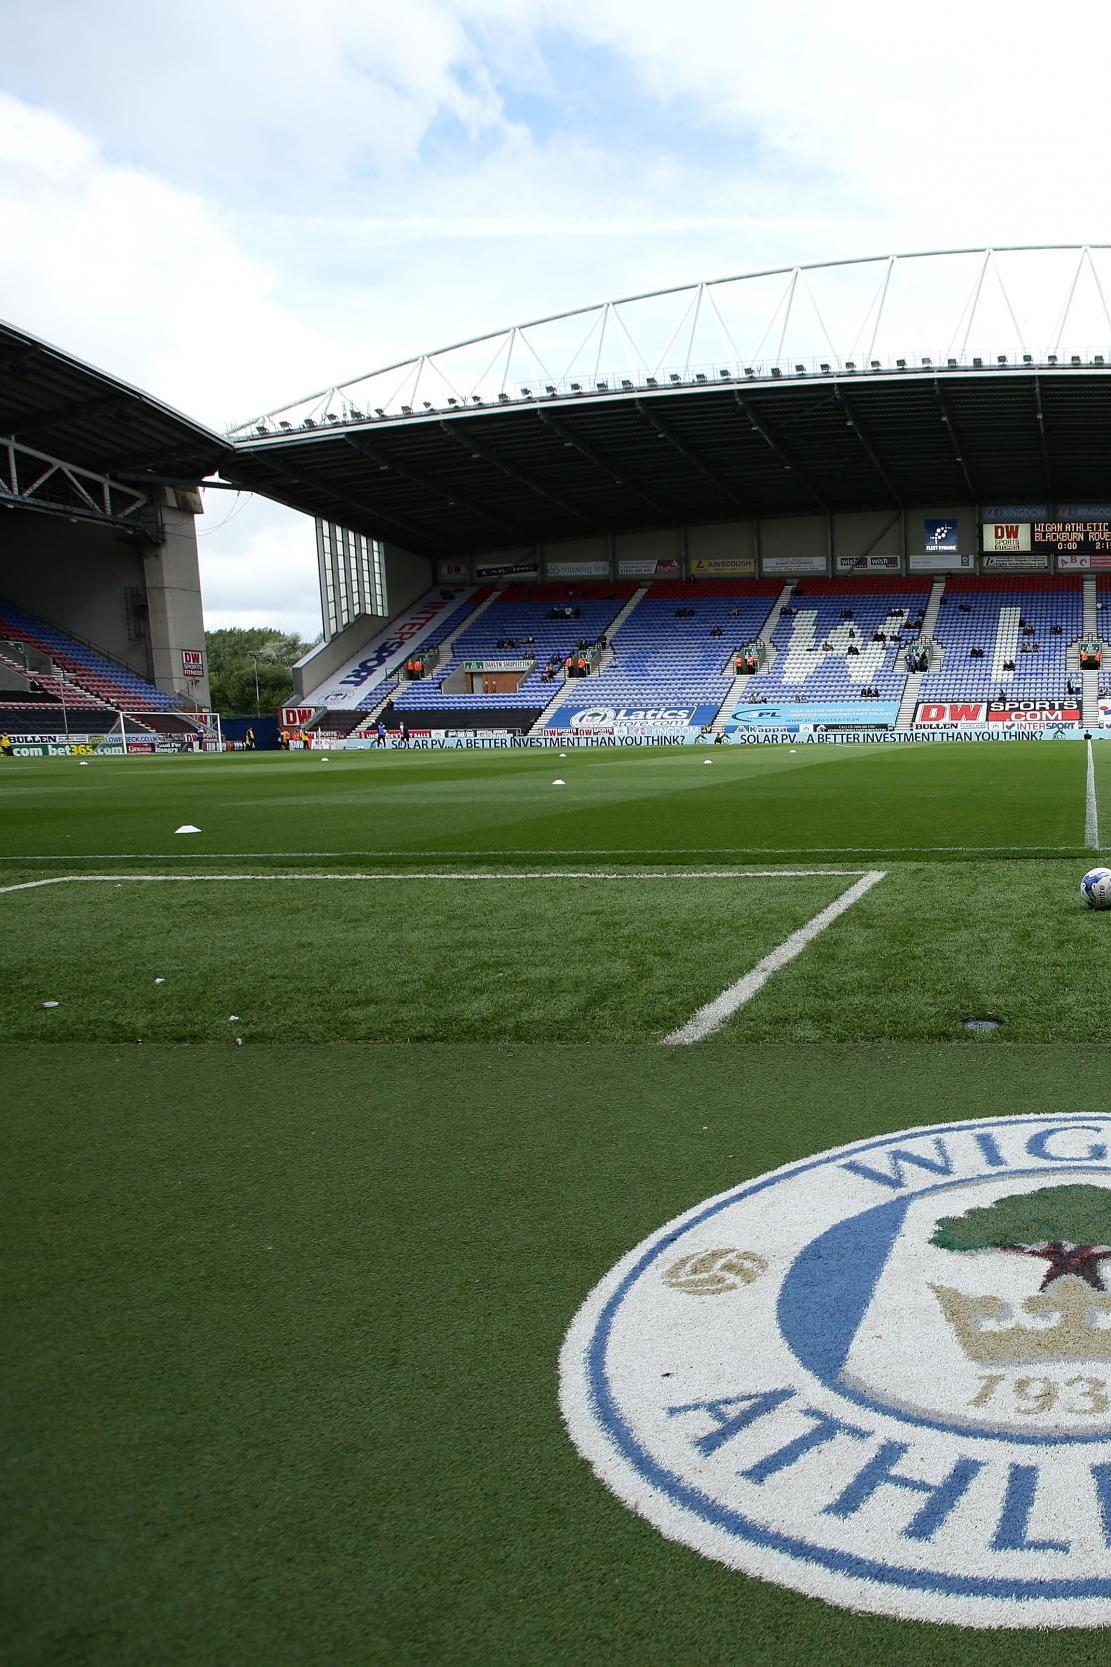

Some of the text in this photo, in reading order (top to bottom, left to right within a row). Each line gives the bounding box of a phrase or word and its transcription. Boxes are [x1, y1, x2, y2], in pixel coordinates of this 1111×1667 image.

[994, 525, 1019, 539] DW
[1034, 523, 1063, 533] WIGAN
[1065, 523, 1109, 533] ATHLETIC
[1034, 532, 1084, 542] BLACKBURN
[339, 601, 449, 688] INTERSPORT
[185, 652, 200, 664] DW
[990, 701, 1077, 711] SPORTS
[286, 709, 315, 725] DW
[616, 707, 691, 720] Latics
[920, 704, 980, 722] DW
[1004, 711, 1063, 721] .COM
[612, 719, 684, 727] store.com
[914, 722, 958, 730] BULLEN
[1016, 721, 1076, 730] INTERSPORT
[651, 726, 700, 735] KINGDOM
[749, 726, 787, 734] Kappa
[9, 735, 57, 744] BULLEN
[740, 733, 784, 745] SOLAR
[807, 733, 817, 744] A
[818, 732, 861, 744] BETTER
[863, 731, 939, 743] INVESTMENT
[941, 731, 975, 742] THAN
[976, 730, 1002, 741] YOU
[1002, 729, 1044, 741] THINK?
[391, 740, 430, 750] SOLAR
[456, 738, 464, 749] A
[466, 738, 508, 749] BETTER
[510, 737, 583, 748] INVESTMENT
[584, 736, 616, 748] THAN
[618, 736, 642, 747] YOU
[643, 735, 685, 746] THINK?
[48, 744, 123, 756] bet365.com
